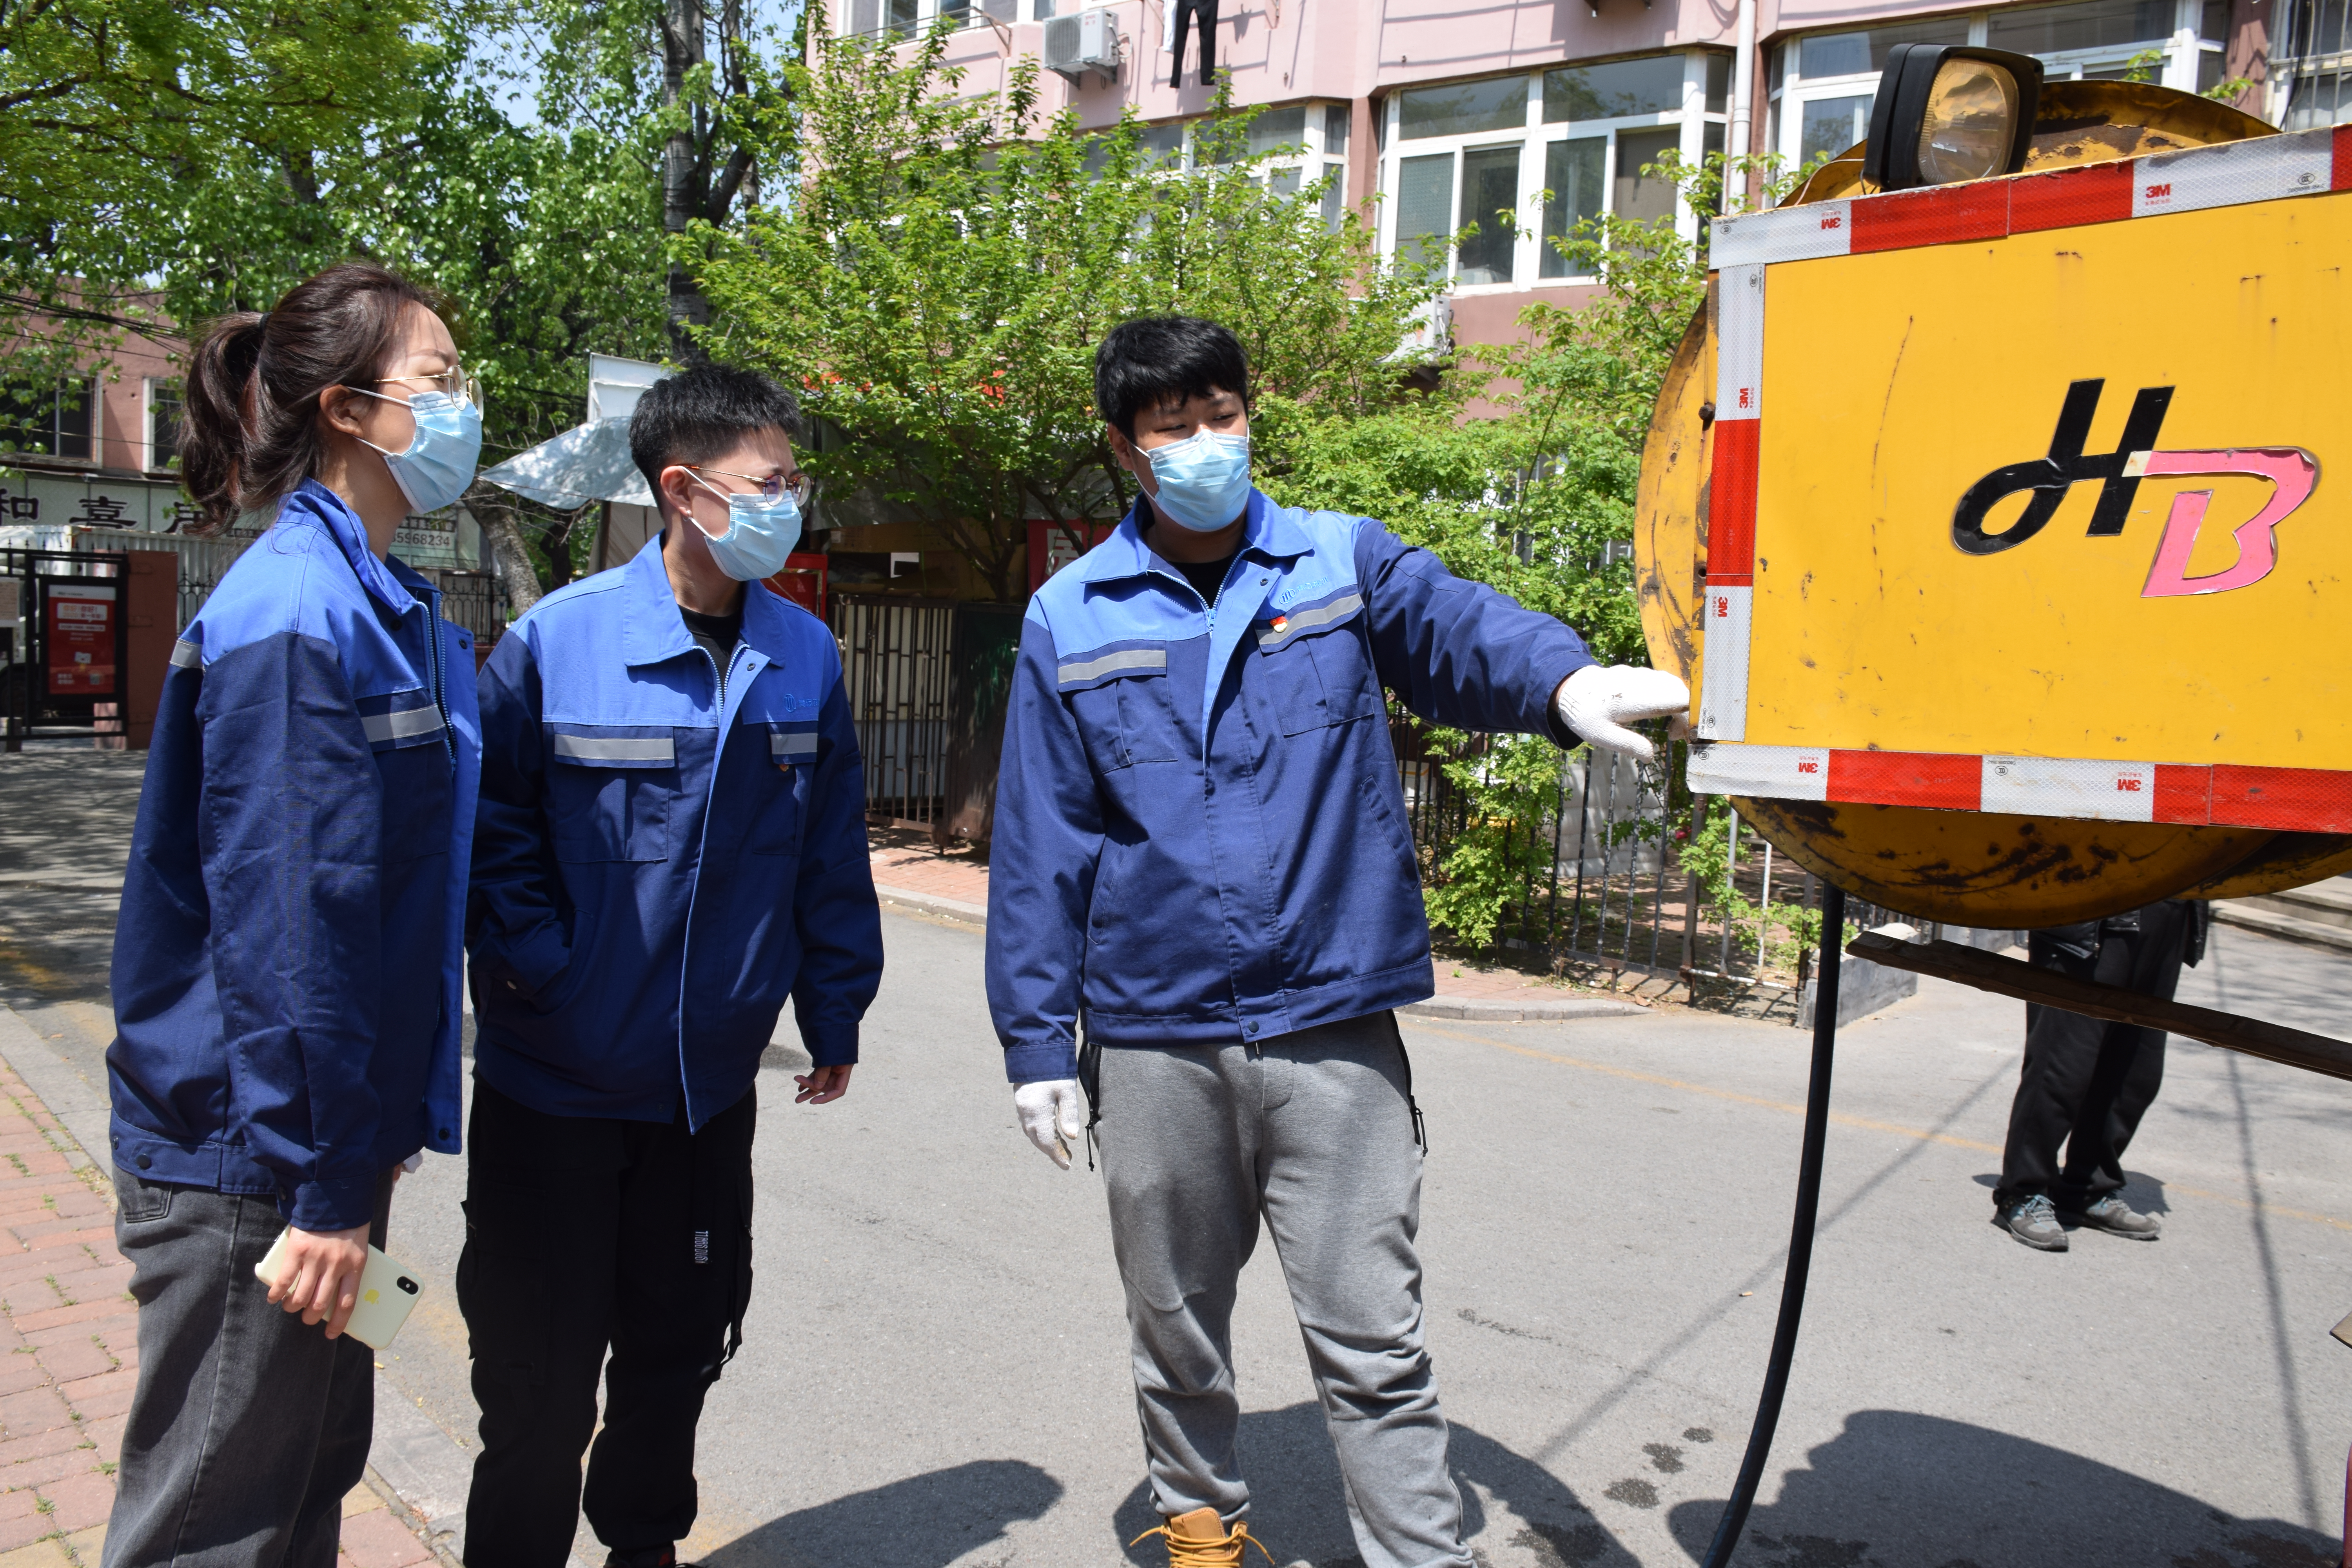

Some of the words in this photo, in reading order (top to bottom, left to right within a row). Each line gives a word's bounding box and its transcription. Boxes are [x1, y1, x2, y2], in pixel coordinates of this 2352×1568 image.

[2146, 184, 2171, 198] 3M
[1821, 218, 1840, 229] 3M
[1739, 388, 1748, 408] 3M
[1718, 597, 1728, 617] 3M
[1798, 762, 1818, 773] 3M
[2117, 779, 2141, 791] 3M
